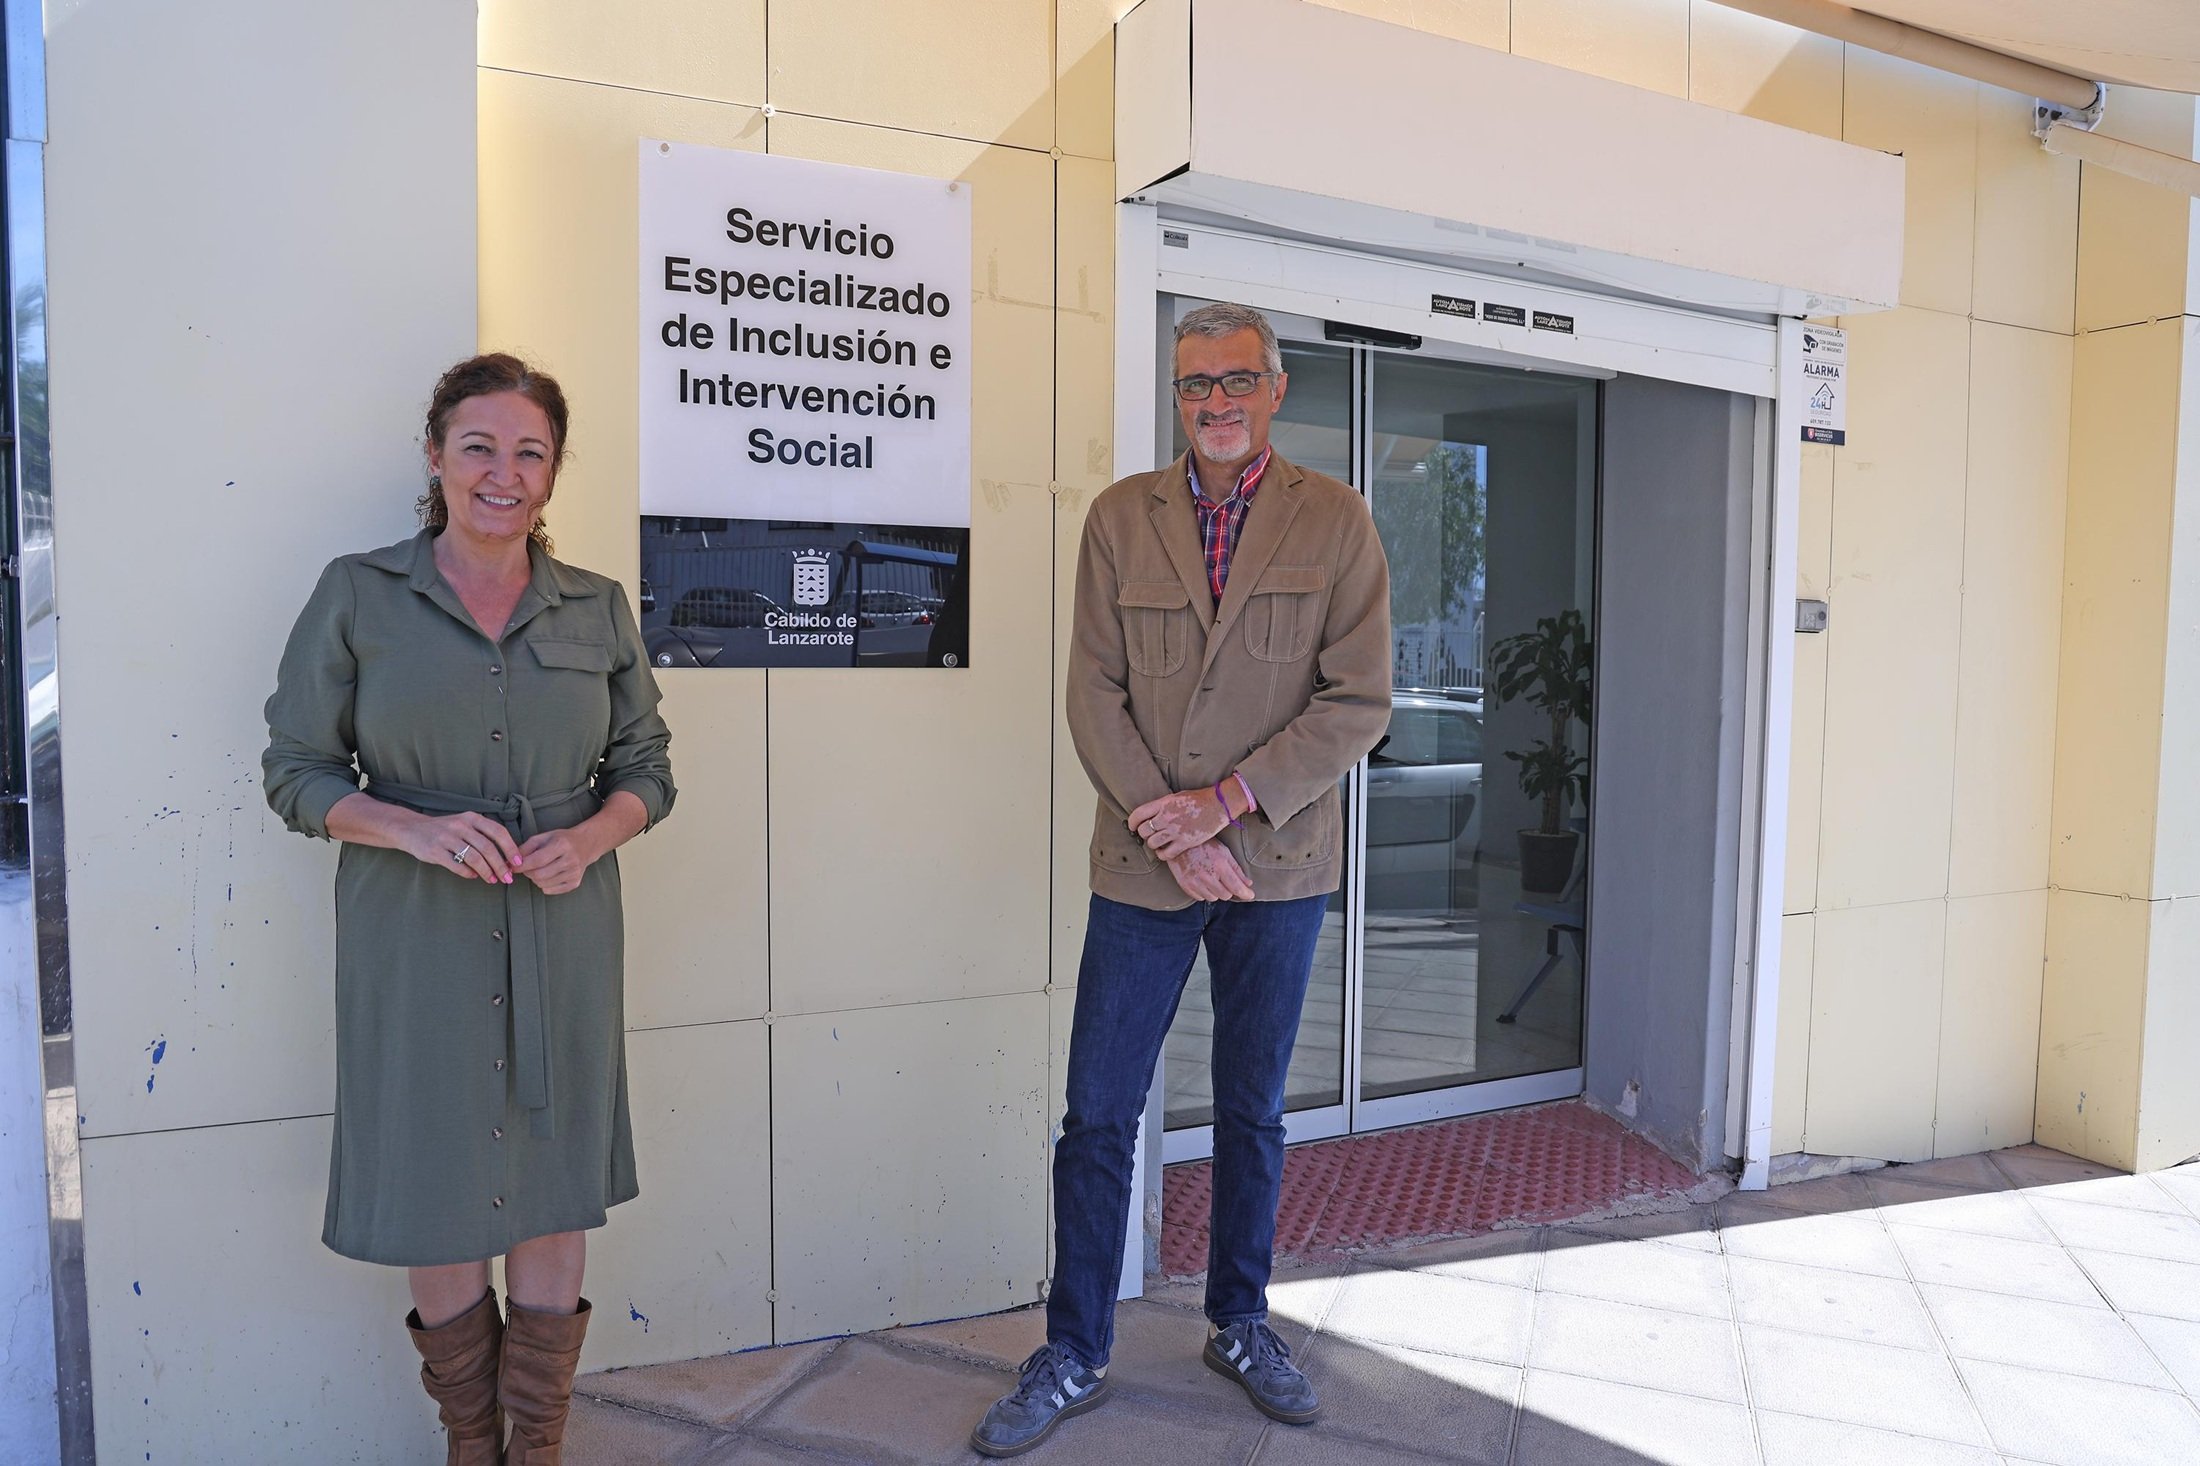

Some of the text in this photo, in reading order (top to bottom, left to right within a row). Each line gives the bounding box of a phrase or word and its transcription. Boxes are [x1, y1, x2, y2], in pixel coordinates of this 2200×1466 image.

[726, 207, 894, 260] Servicio
[664, 255, 950, 318] Especializado
[661, 312, 952, 370] de Inclusión e
[1803, 362, 1840, 379] ALARMA
[679, 368, 936, 421] Intervención
[747, 428, 873, 469] Social
[764, 612, 857, 628] Cabildo de
[768, 630, 854, 646] Lanzarote
